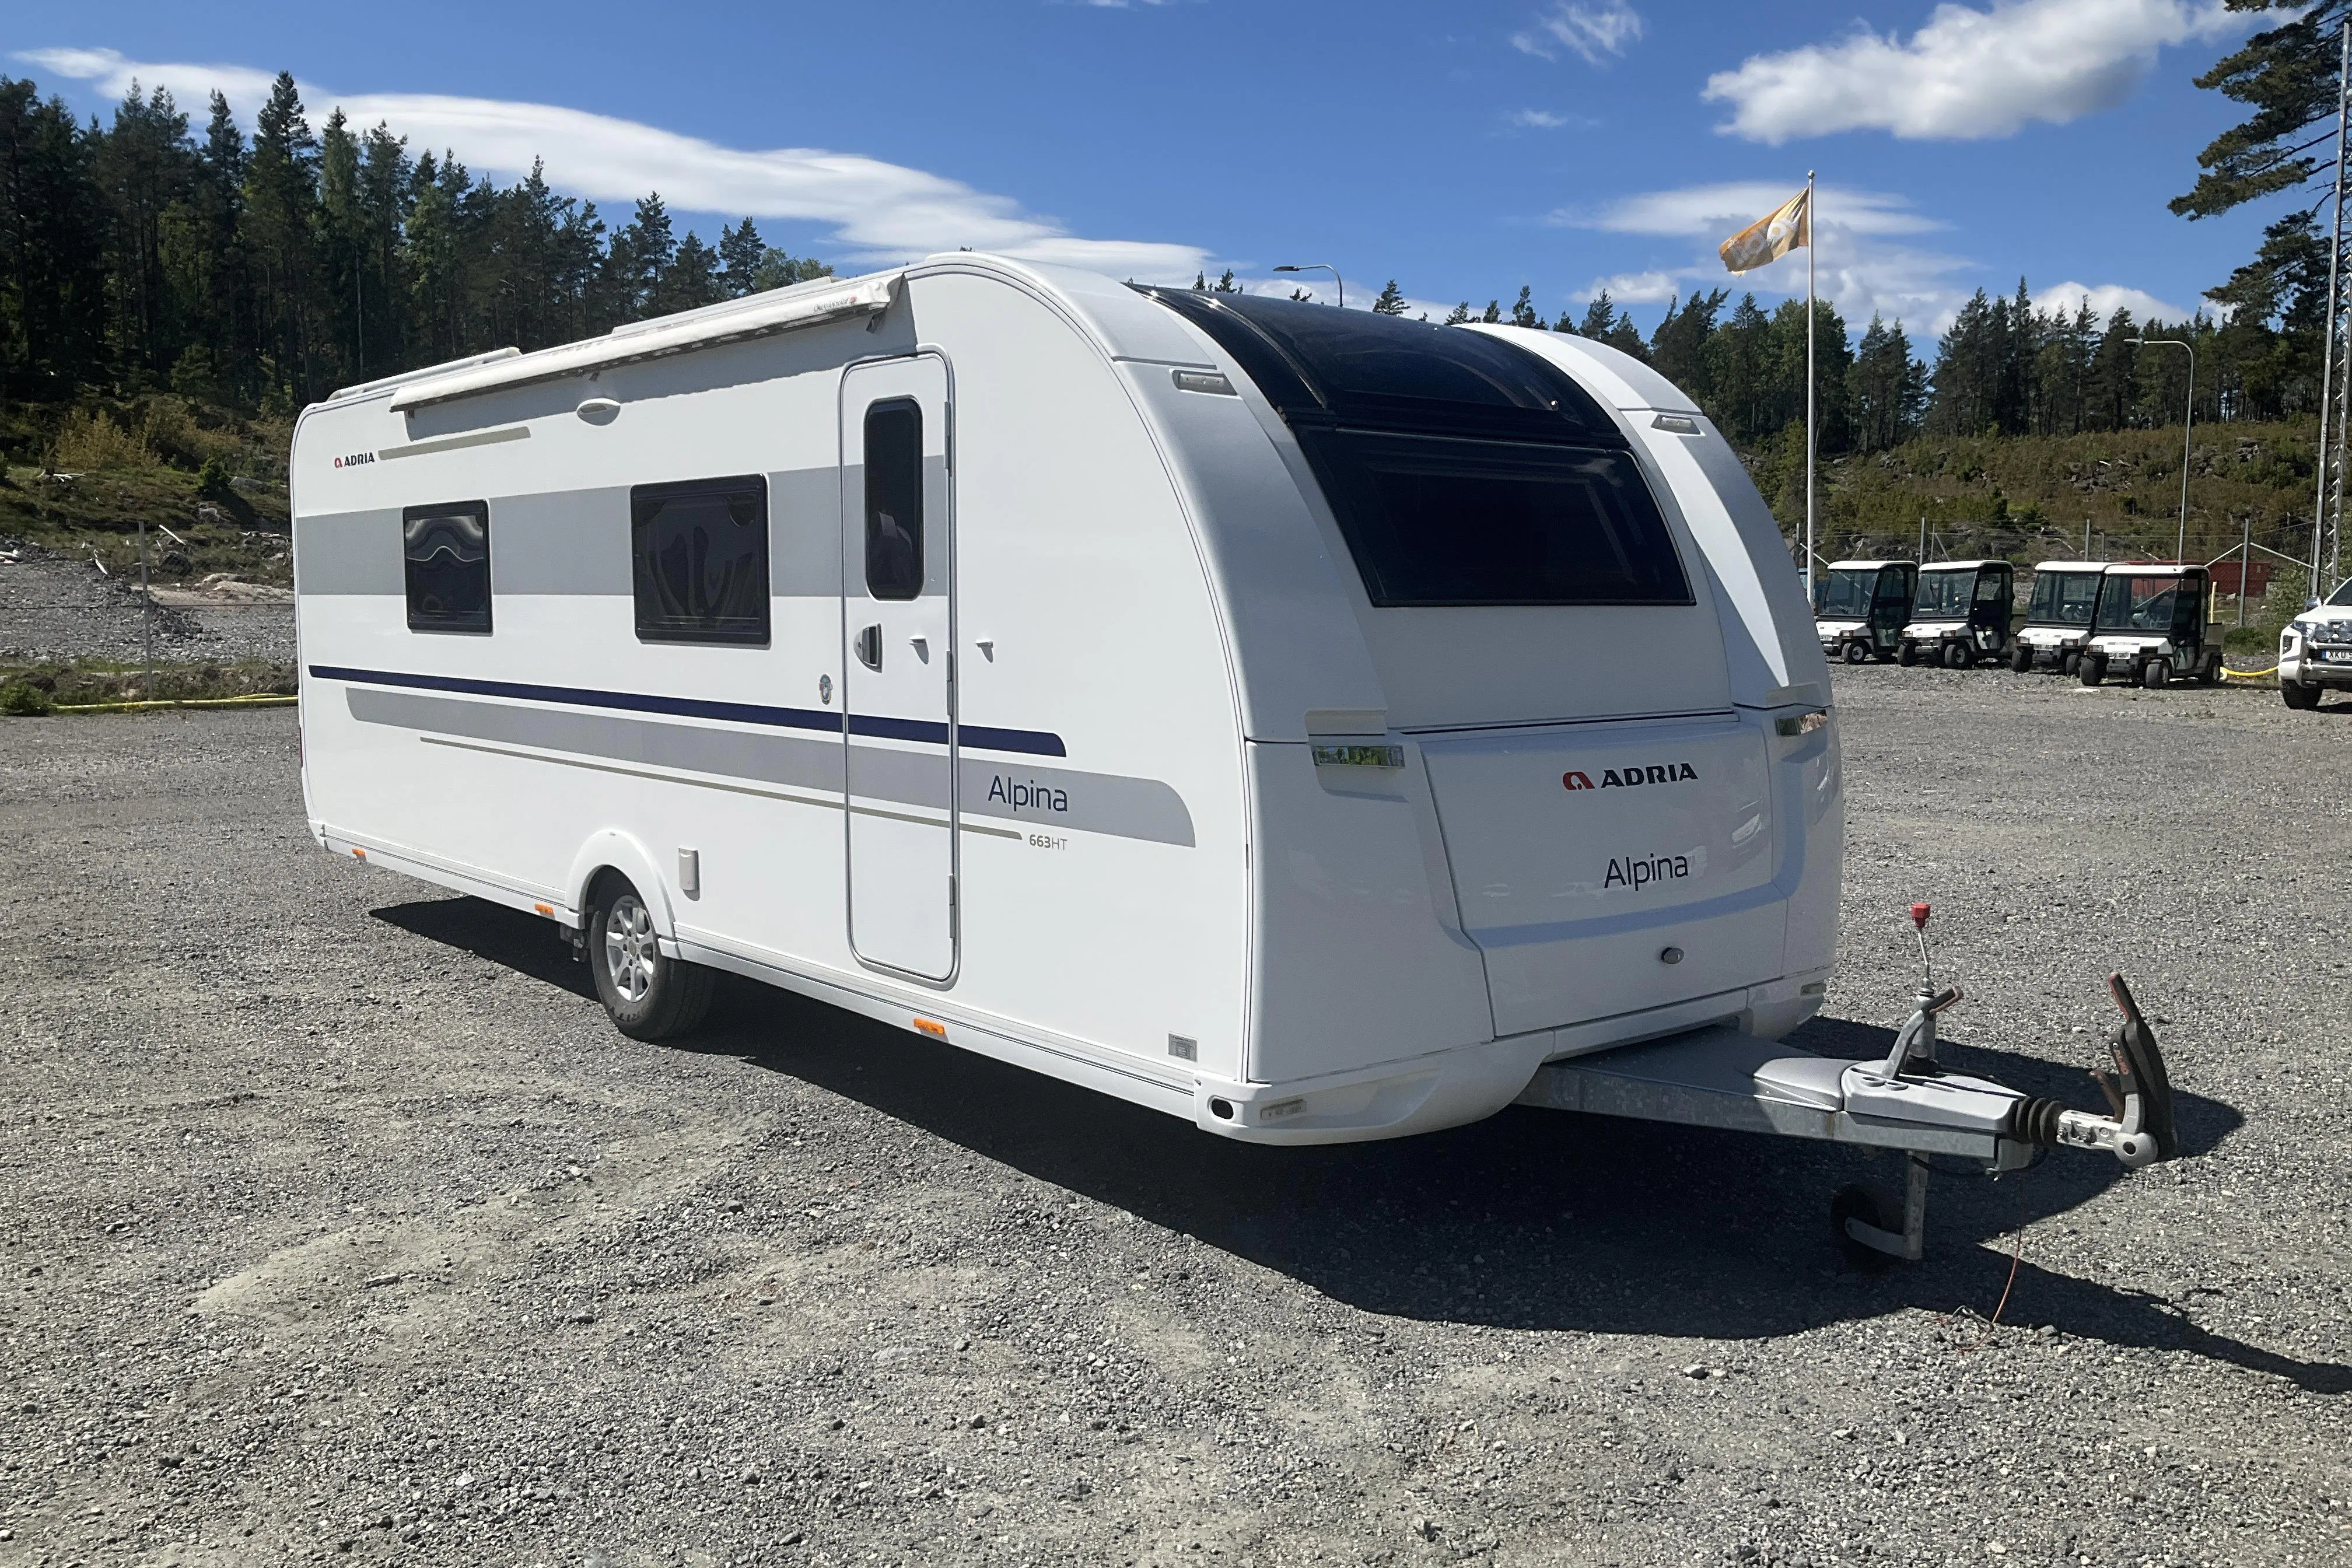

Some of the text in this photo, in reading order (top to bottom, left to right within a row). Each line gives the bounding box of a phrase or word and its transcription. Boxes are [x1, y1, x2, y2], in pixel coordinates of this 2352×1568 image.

[344, 452, 374, 467] ADRIA
[1601, 762, 1698, 789] ADRIA
[988, 775, 1068, 812] Alpina
[1030, 834, 1068, 850] 663HT
[1604, 853, 1689, 891] Alpina
